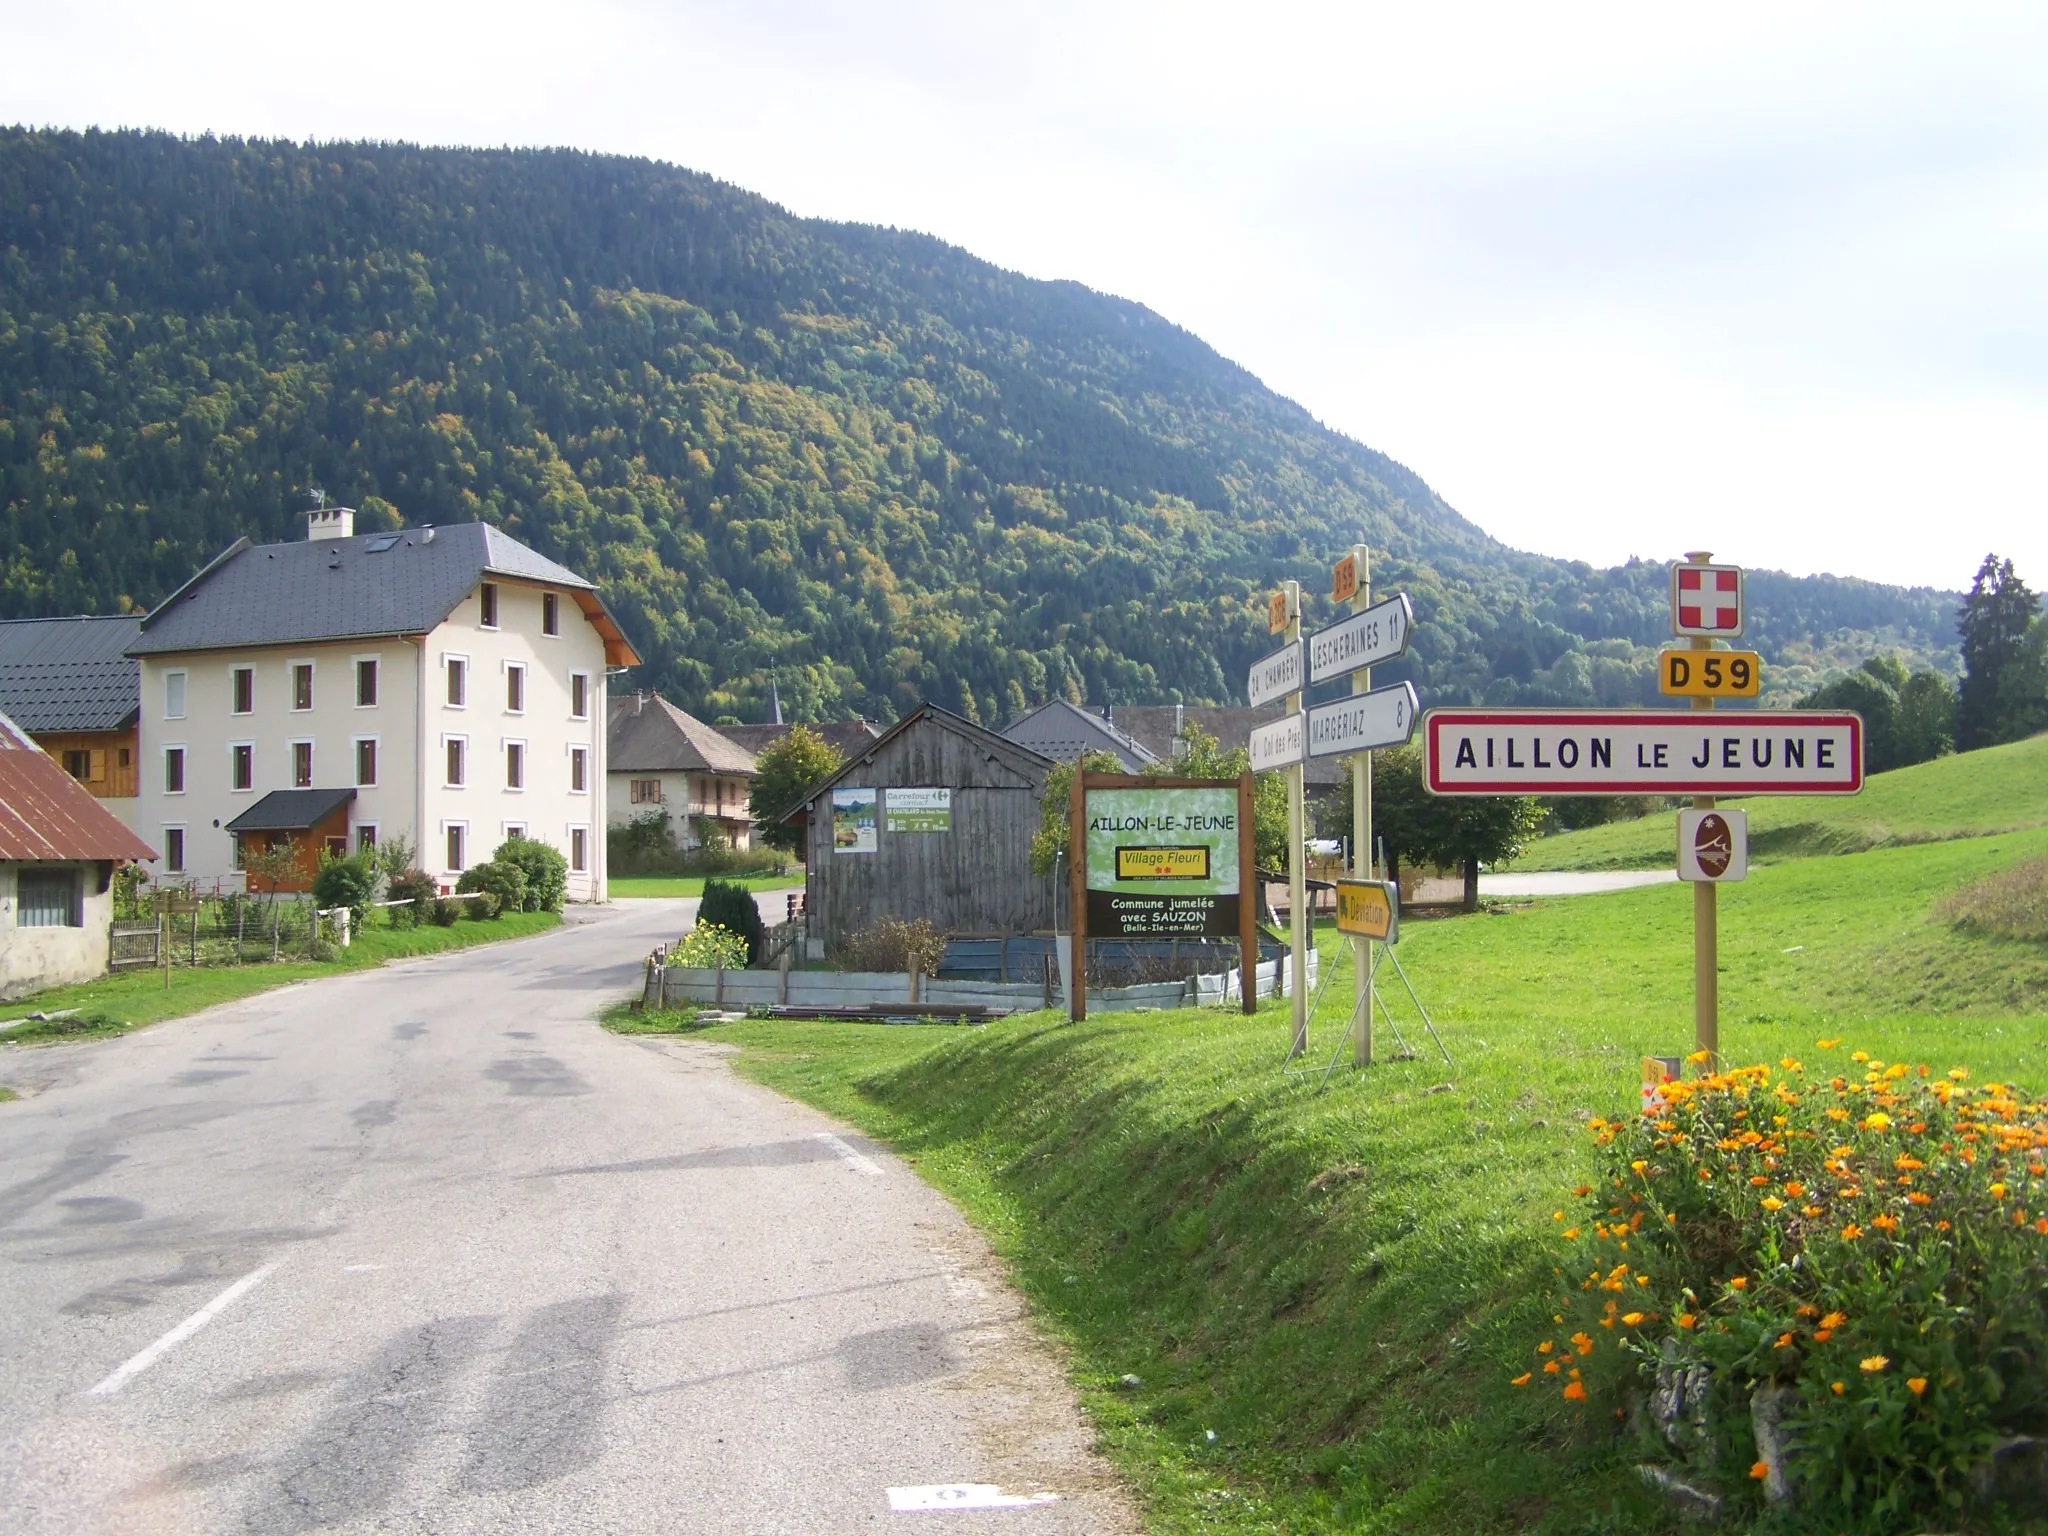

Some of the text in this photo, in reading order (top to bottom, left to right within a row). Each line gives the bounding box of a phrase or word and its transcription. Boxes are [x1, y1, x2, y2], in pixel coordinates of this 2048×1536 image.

[1312, 612, 1398, 671] LESCHERAINES 11
[1251, 653, 1299, 697] 24 CHAMBÉRY
[1669, 657, 1750, 689] D 59
[1311, 700, 1403, 744] MARGÉRIAZ 8
[1264, 735, 1274, 757] Col
[1276, 733, 1285, 754] des
[1454, 737, 1836, 769] AILLON LE JEUNE
[887, 792, 930, 800] Carrefour
[1090, 815, 1235, 831] AILLON-LE-JEUNE
[1125, 851, 1201, 866] Village Fleuri
[1111, 897, 1215, 911] Commune jumelée
[1350, 895, 1383, 924] Déviation
[1120, 911, 1207, 922] avec SAUZON
[1123, 923, 1204, 932] (Belle-Ile-en-Mer)
